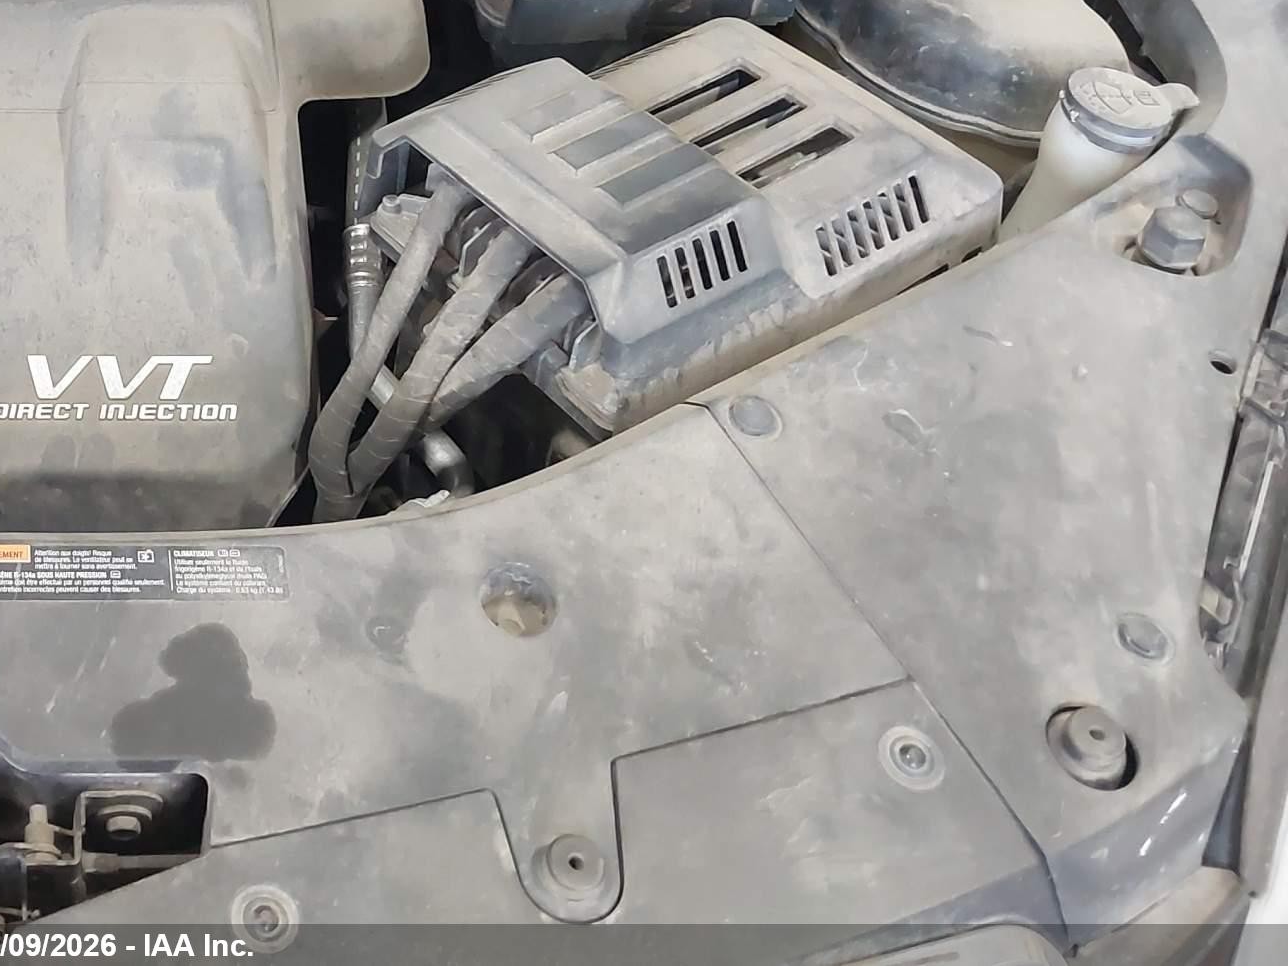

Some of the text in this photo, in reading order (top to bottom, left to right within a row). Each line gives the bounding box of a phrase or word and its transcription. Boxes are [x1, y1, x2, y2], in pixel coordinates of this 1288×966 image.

[26, 354, 213, 401] VVT
[99, 403, 238, 421] INJECTION
[100, 586, 112, 594] des
